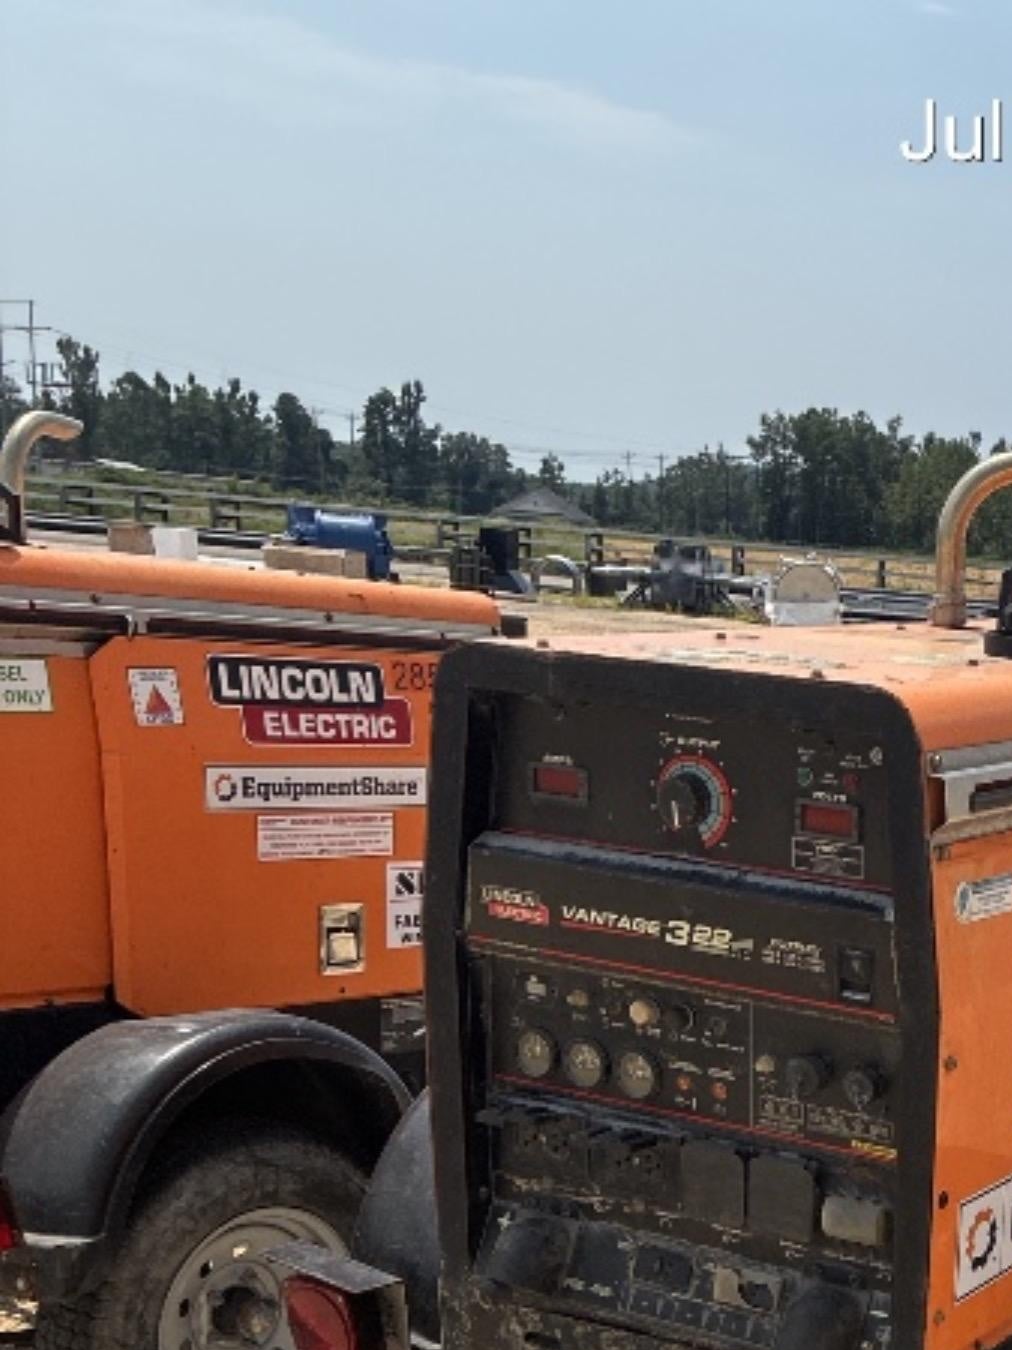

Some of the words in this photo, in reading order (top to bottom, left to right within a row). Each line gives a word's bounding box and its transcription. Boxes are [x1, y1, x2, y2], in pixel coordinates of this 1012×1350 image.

[217, 661, 376, 703] LINCOLN
[262, 710, 398, 740] ELECTRIC
[241, 776, 418, 802] EquipmentShare
[562, 904, 662, 937] VANTAGE
